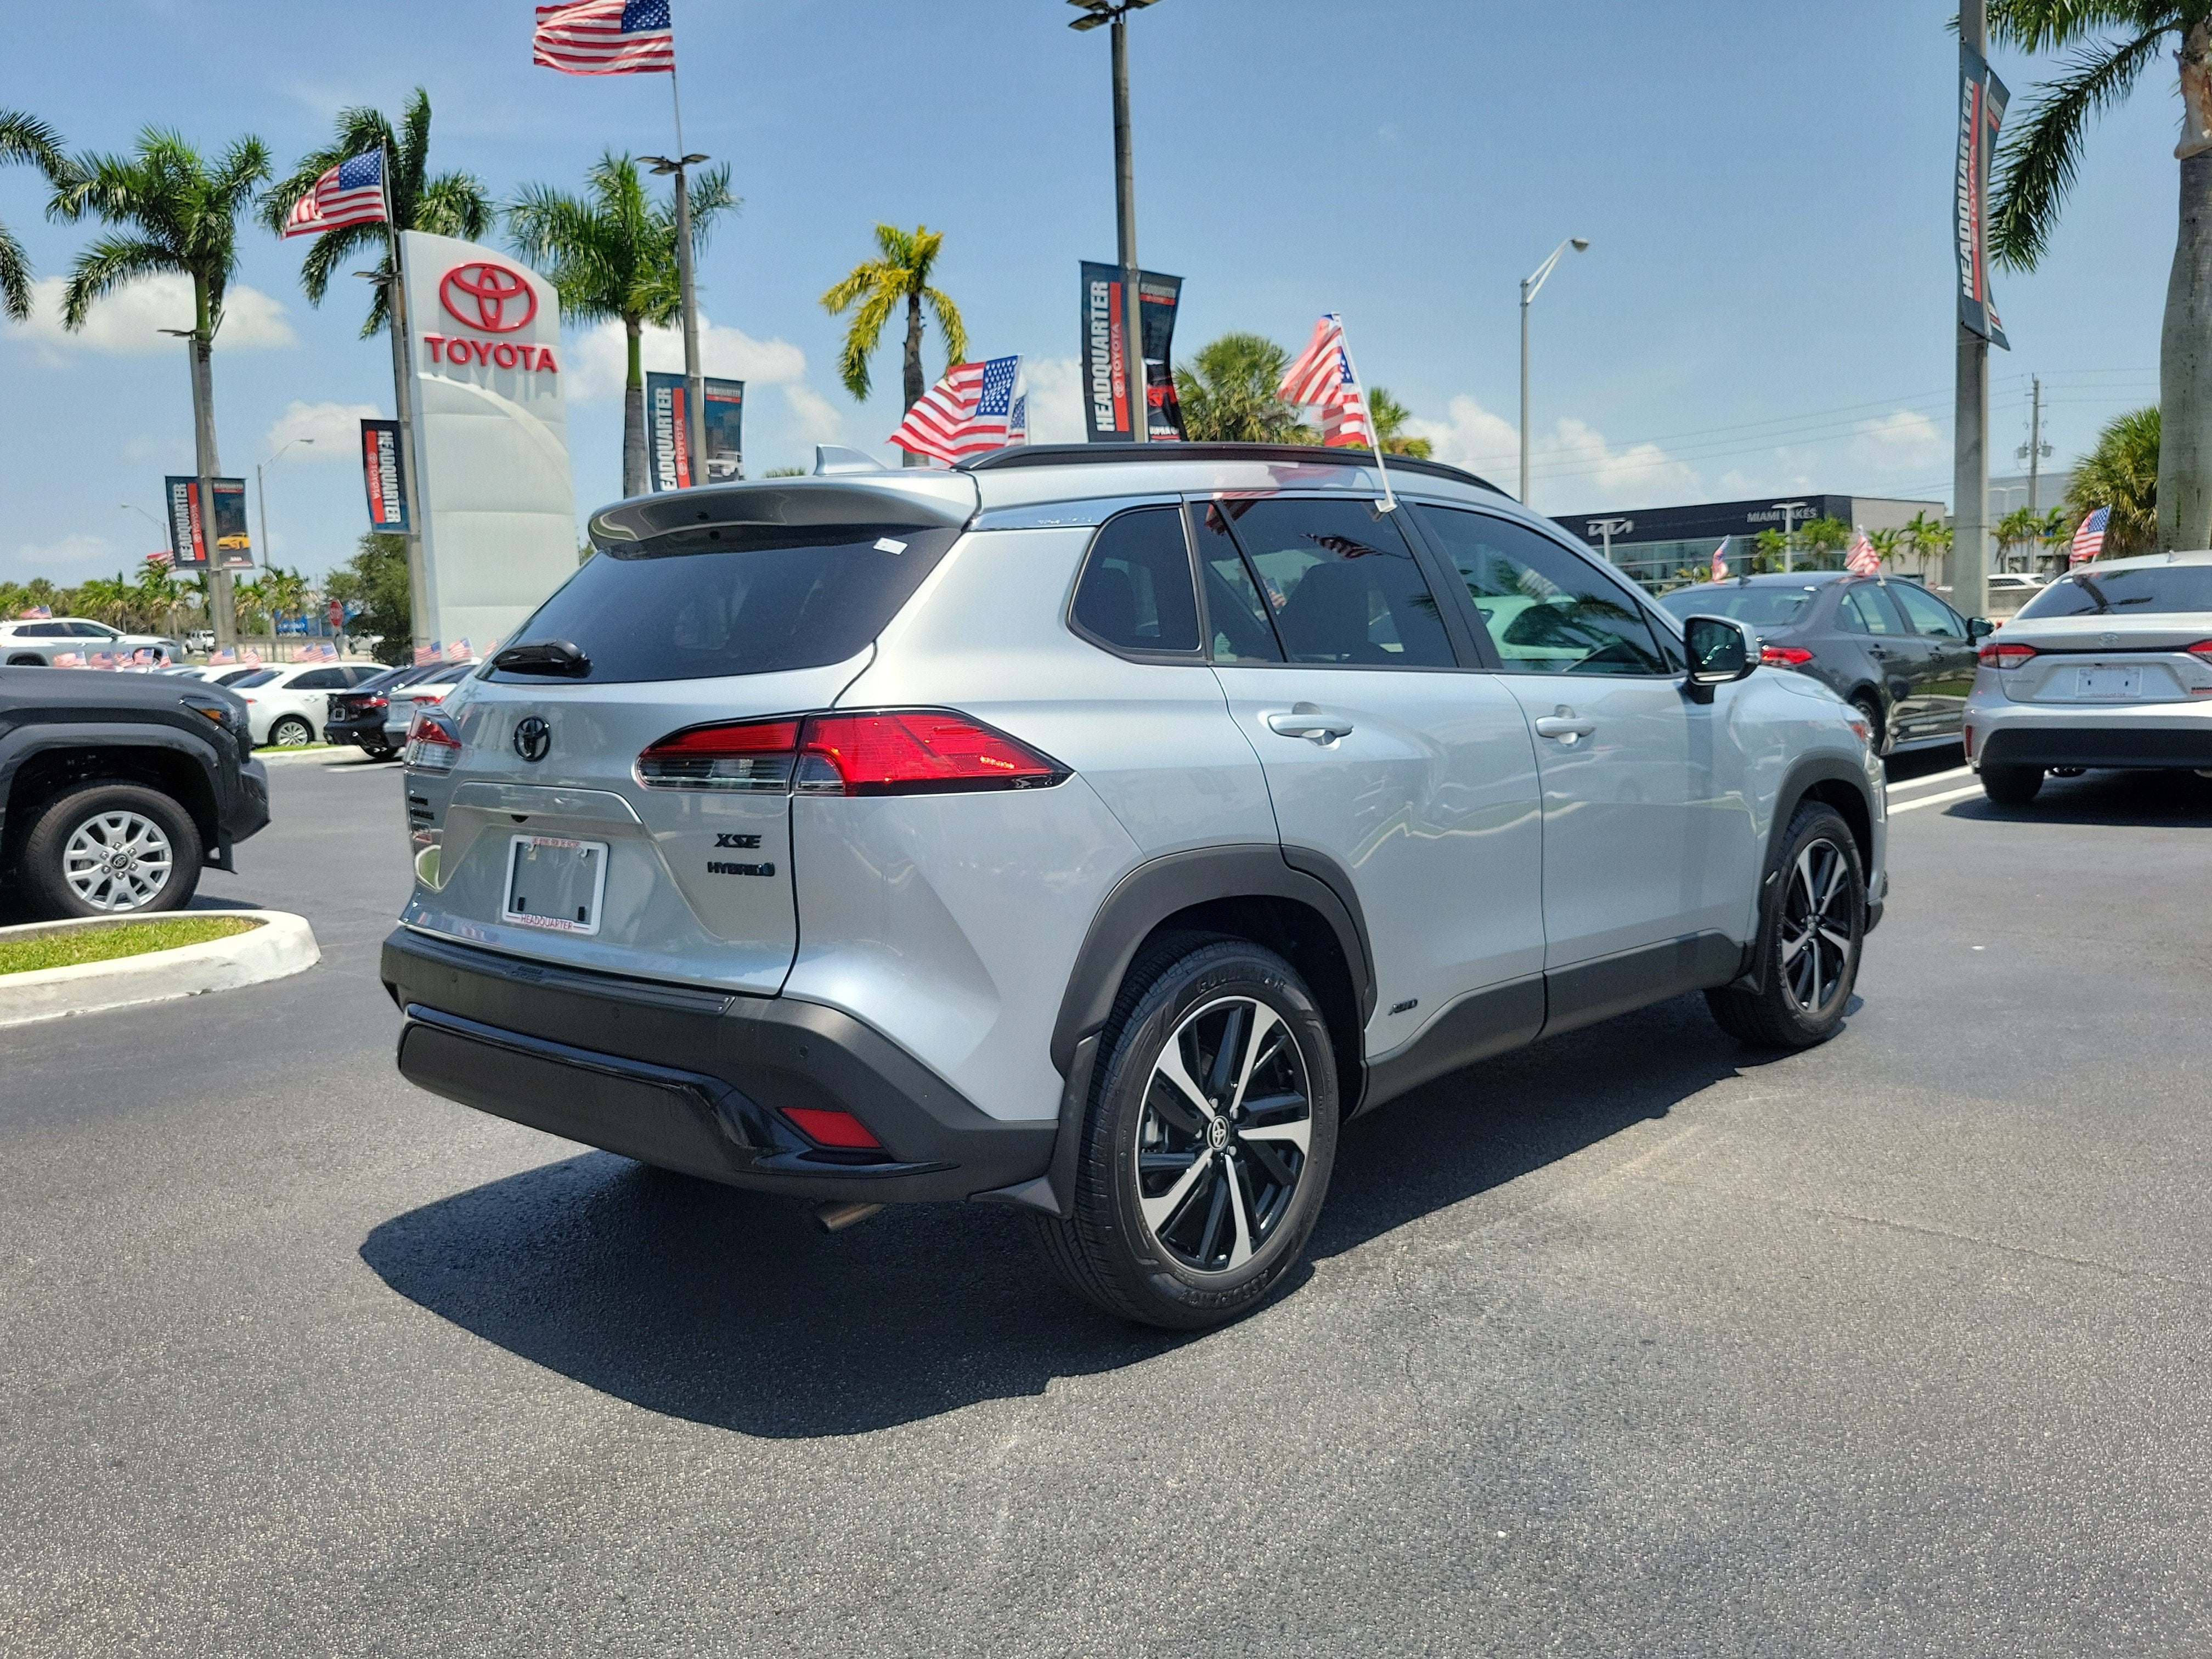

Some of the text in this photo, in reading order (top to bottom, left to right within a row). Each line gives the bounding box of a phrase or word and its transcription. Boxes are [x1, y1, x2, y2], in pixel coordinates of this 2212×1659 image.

[1957, 76, 1974, 299] HEADQUARTER
[425, 336, 558, 373] TOYOTA
[1090, 281, 1115, 432] HEADQUARTER
[1110, 323, 1124, 377] TOYOTA
[655, 387, 679, 491] EADQUARTER
[675, 419, 686, 460] TOYOTA
[369, 464, 381, 499] TOYOTA
[377, 430, 402, 523] HEADQUARTER
[173, 483, 196, 561] HEADQUARTER
[1747, 511, 1779, 523] MIAMI
[714, 833, 762, 848] XSE
[521, 914, 573, 930] HEADQUARTER
